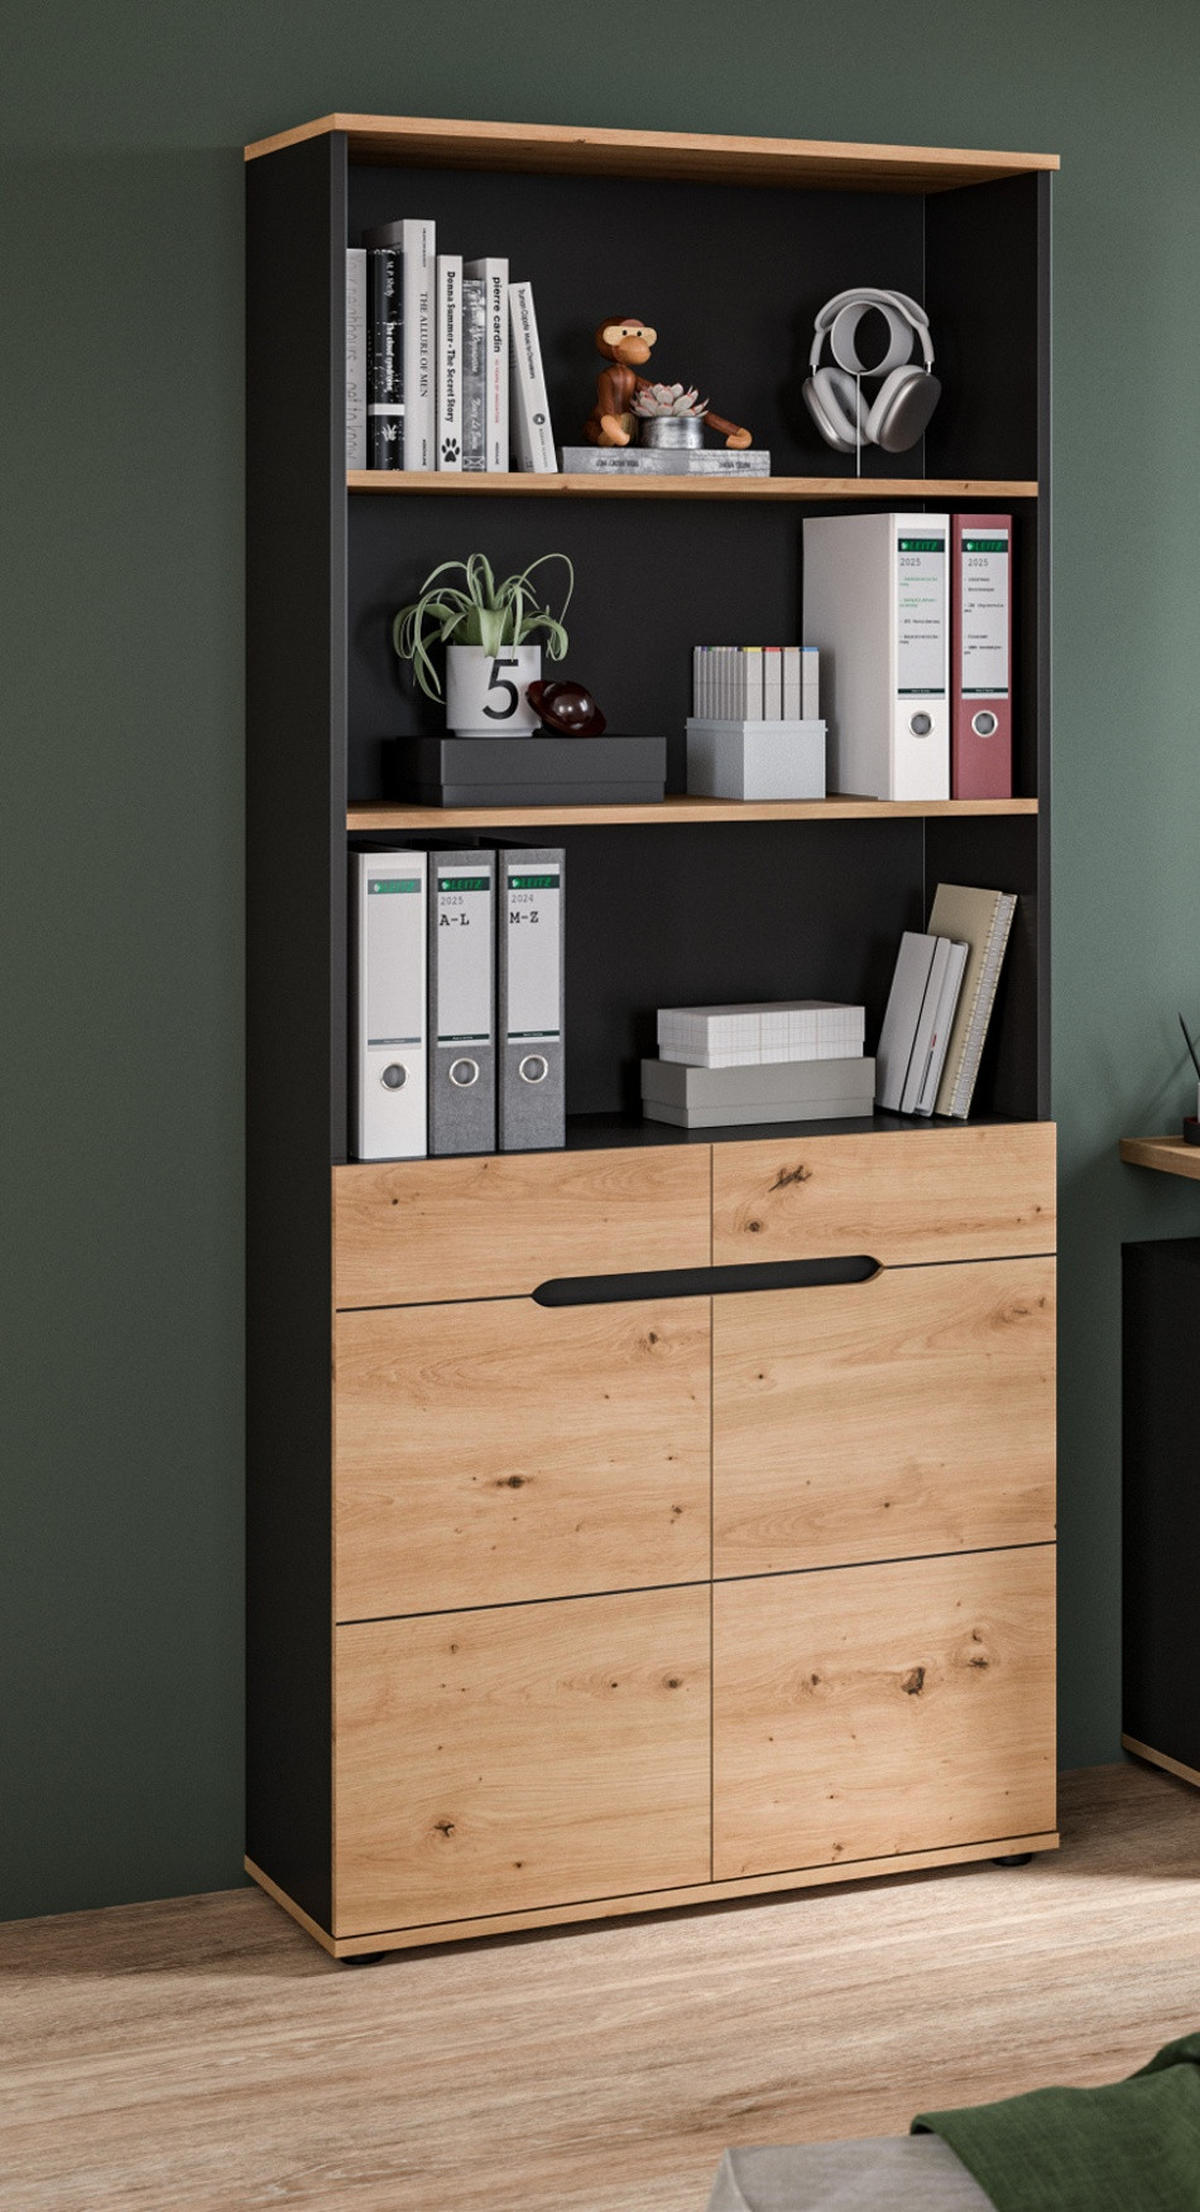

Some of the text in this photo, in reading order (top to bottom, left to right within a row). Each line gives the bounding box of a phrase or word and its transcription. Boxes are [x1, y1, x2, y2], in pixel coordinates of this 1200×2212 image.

[446, 271, 455, 302] Donna
[492, 277, 502, 353] pierre cardin
[446, 303, 455, 342] Summer
[419, 292, 428, 398] THE ALLURE OF MEN
[446, 349, 455, 367] The
[446, 368, 455, 396] Secret
[445, 398, 455, 423] Story
[900, 558, 921, 566] 2025
[968, 558, 989, 567] 2025
[482, 659, 519, 720] 5
[382, 881, 415, 892] LEITZ
[451, 880, 483, 890] LEITZ
[521, 877, 552, 888] LEITZ
[440, 896, 464, 905] 2025
[511, 894, 534, 903] 2024
[439, 914, 469, 926] A-L
[509, 911, 539, 924] M-Z
